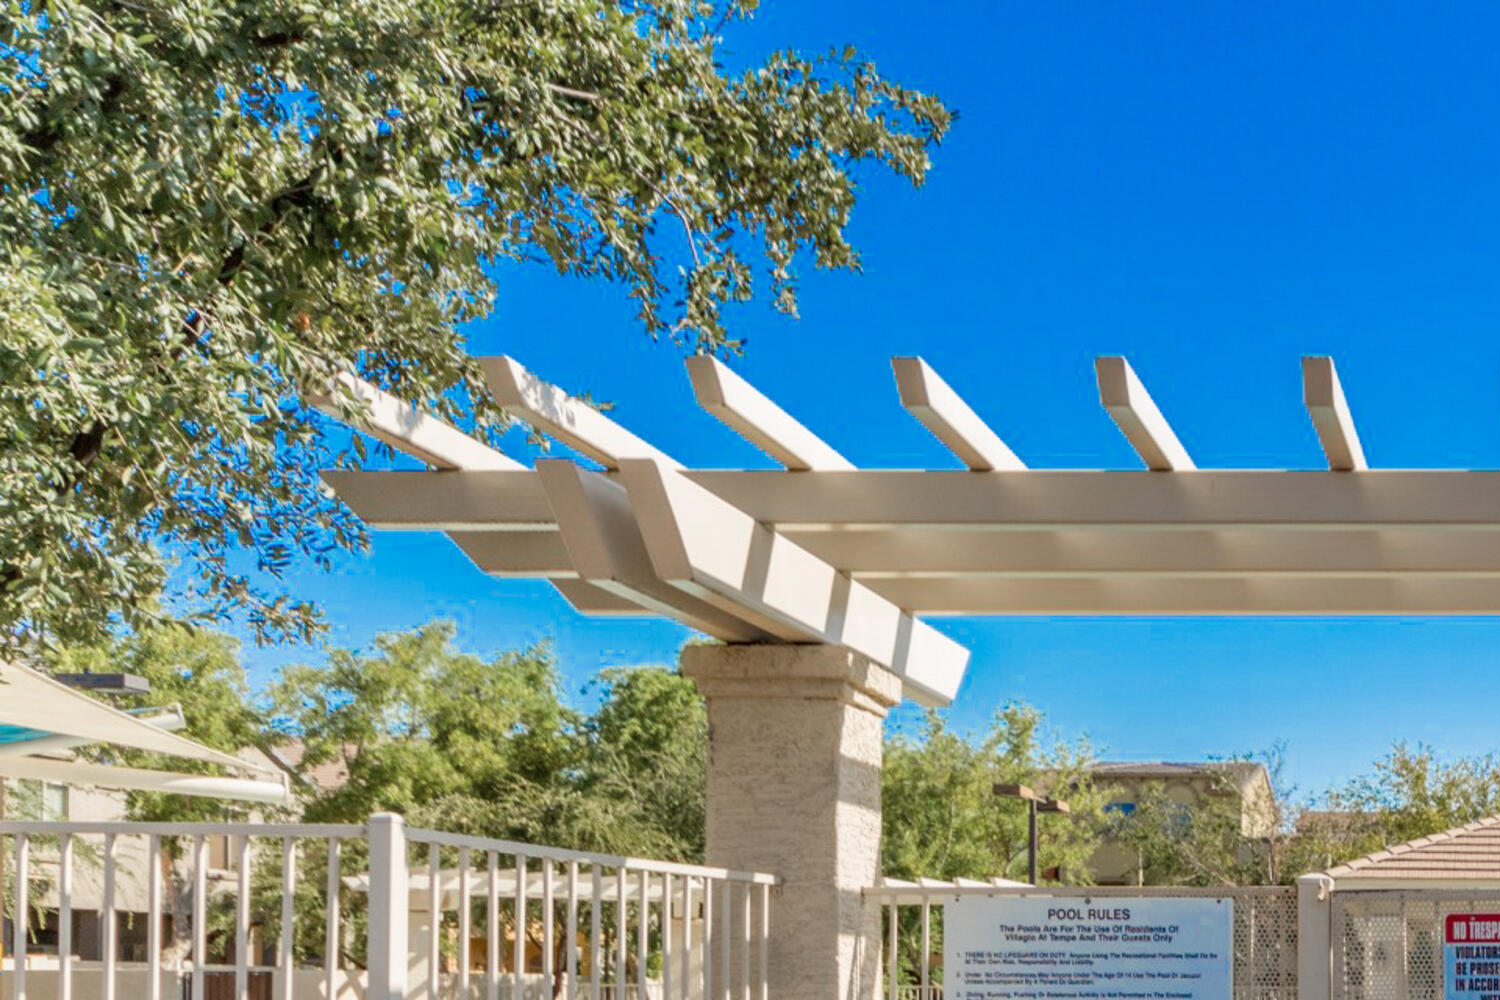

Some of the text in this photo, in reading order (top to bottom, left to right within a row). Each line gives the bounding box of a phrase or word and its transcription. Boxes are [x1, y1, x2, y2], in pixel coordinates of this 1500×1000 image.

[1048, 909, 1131, 920] POOL RULES
[1000, 925, 1179, 933] The Pools Are For The Use Of Residents Of
[1453, 920, 1466, 940] NO
[1038, 934, 1048, 942] At
[1050, 934, 1077, 943] Tempe
[1079, 934, 1096, 942] And
[1098, 934, 1119, 942] Their
[1121, 934, 1151, 942] Guests
[1153, 934, 1173, 943] Only
[1456, 962, 1467, 975] BE
[1456, 978, 1465, 991] IN
